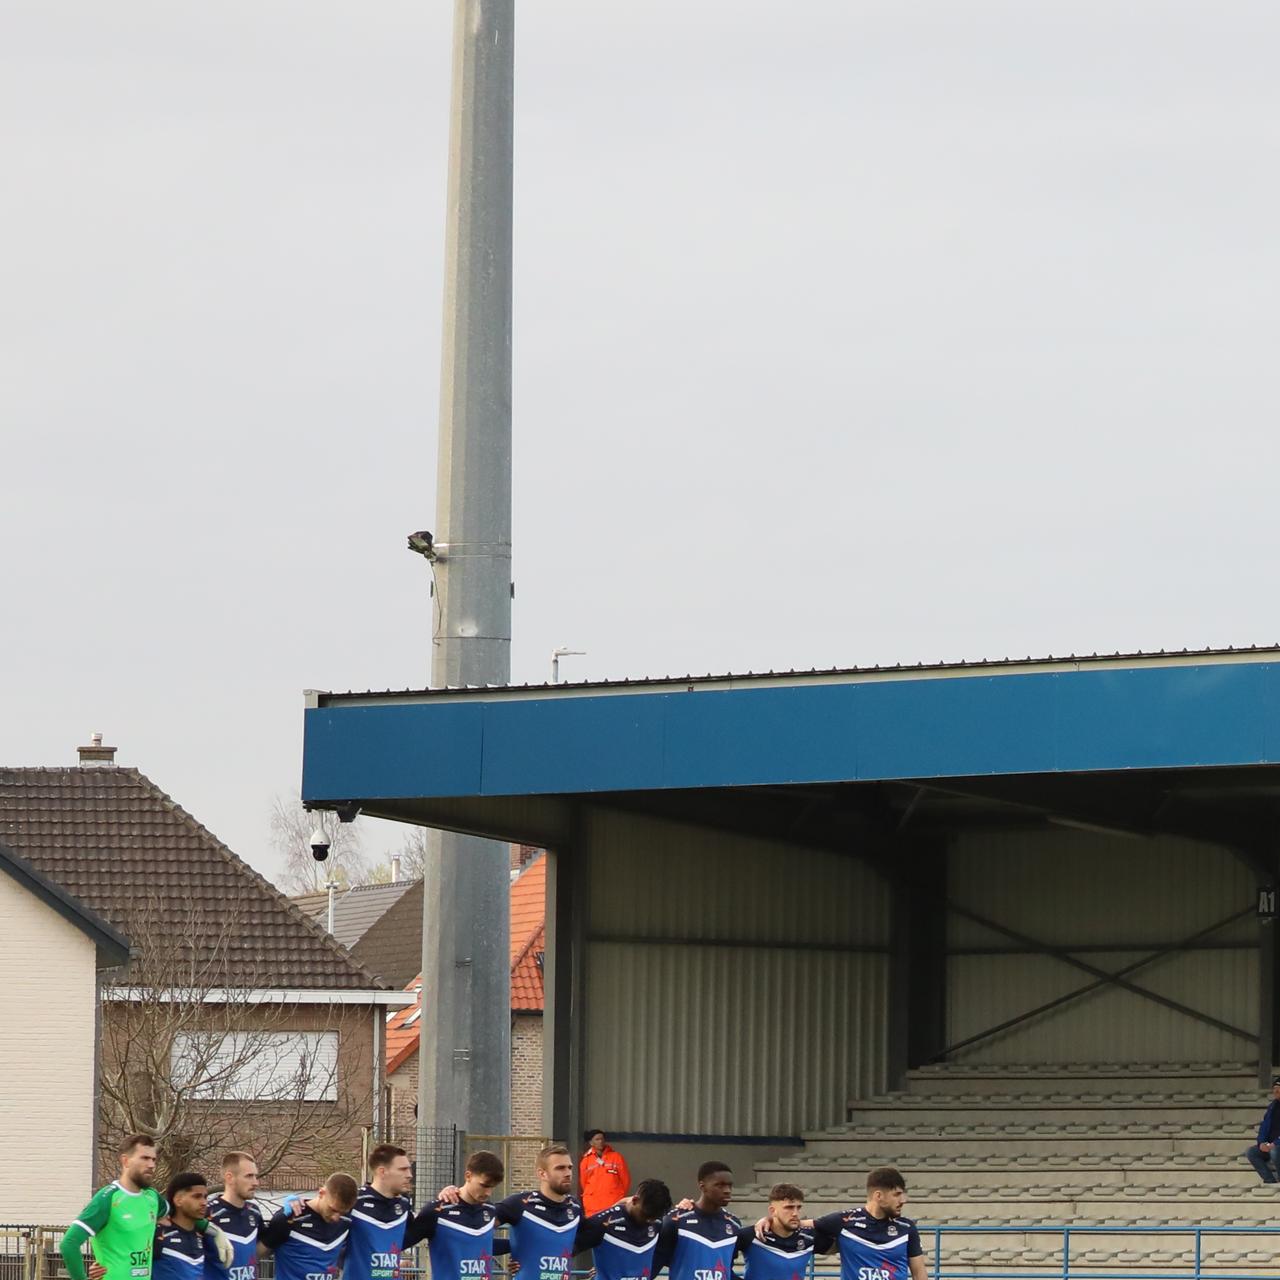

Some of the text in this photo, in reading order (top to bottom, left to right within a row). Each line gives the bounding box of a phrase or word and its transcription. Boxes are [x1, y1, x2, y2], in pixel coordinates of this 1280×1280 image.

[1258, 891, 1275, 913] A1
[370, 1253, 399, 1268] STAR
[460, 1260, 486, 1274] STAR
[539, 1256, 568, 1271] STAR
[228, 1266, 255, 1280] STAR
[540, 1273, 562, 1280] SPORT
